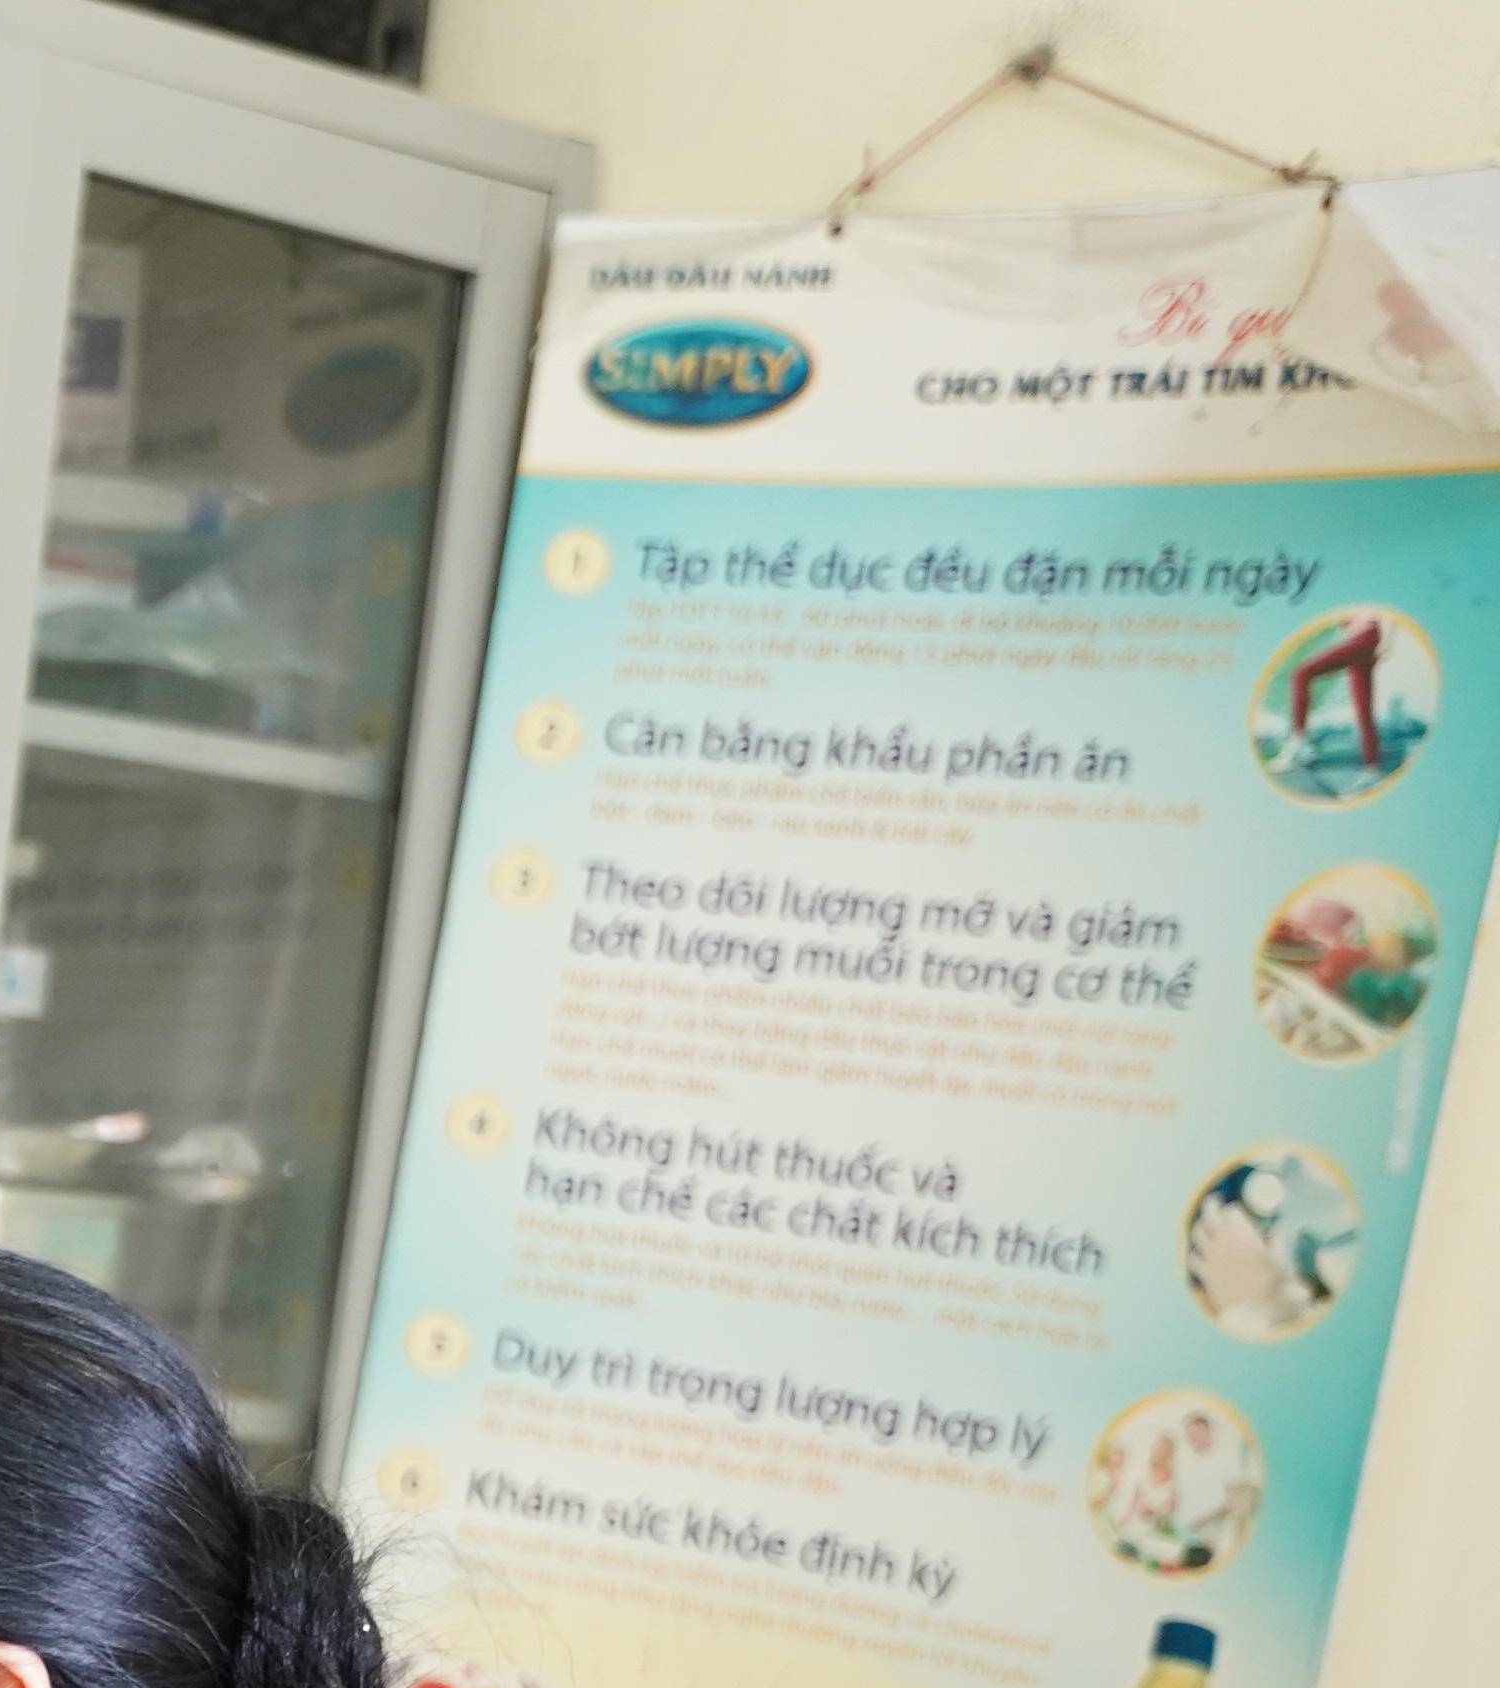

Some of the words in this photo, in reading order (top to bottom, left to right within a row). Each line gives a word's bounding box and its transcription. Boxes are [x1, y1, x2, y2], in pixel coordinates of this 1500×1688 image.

[913, 368, 999, 404] CHO
[1011, 362, 1094, 411] MỘT
[1108, 356, 1190, 400] TRÁI
[1202, 363, 1267, 398] TIM
[636, 536, 710, 592] Tập
[725, 536, 801, 589] thể
[808, 543, 895, 599] dục
[903, 541, 991, 594] đều
[1003, 545, 1091, 603] đặn
[1102, 541, 1196, 596] mỗi
[1202, 543, 1322, 608] ngày
[603, 709, 687, 757] Cân
[698, 712, 811, 778] bằng
[943, 726, 1061, 786] phần
[1072, 735, 1132, 783] ăn
[579, 856, 687, 911] Theo
[698, 865, 773, 918] dõi
[778, 868, 907, 942] lượng
[919, 891, 996, 938] mỡ
[1007, 895, 1056, 943] và
[1066, 902, 1181, 956] giảm
[568, 908, 646, 960] bớt
[655, 920, 782, 984] lượng
[920, 947, 1040, 1009] trong
[1052, 960, 1113, 1003] cơ
[1118, 956, 1200, 1011] thể
[534, 1104, 677, 1176] Không
[687, 1122, 766, 1178] hút
[773, 1137, 901, 1196] thuốc
[910, 1154, 961, 1201] và
[524, 1156, 605, 1211] hạn
[616, 1168, 700, 1222] chế
[704, 1182, 781, 1234] các
[786, 1194, 882, 1248] chất
[891, 1203, 981, 1260] kích
[993, 1222, 1107, 1279] thích
[491, 1325, 579, 1390] Duy
[589, 1345, 637, 1388] trì
[647, 1357, 764, 1422] trọng
[775, 1370, 901, 1446] lượng
[911, 1392, 999, 1457] hợp
[1009, 1411, 1054, 1470] lý
[465, 1468, 590, 1523] Khám
[598, 1493, 673, 1545] sức
[681, 1502, 790, 1567] khỏe
[798, 1528, 897, 1585] định
[907, 1546, 963, 1607] kỳ
